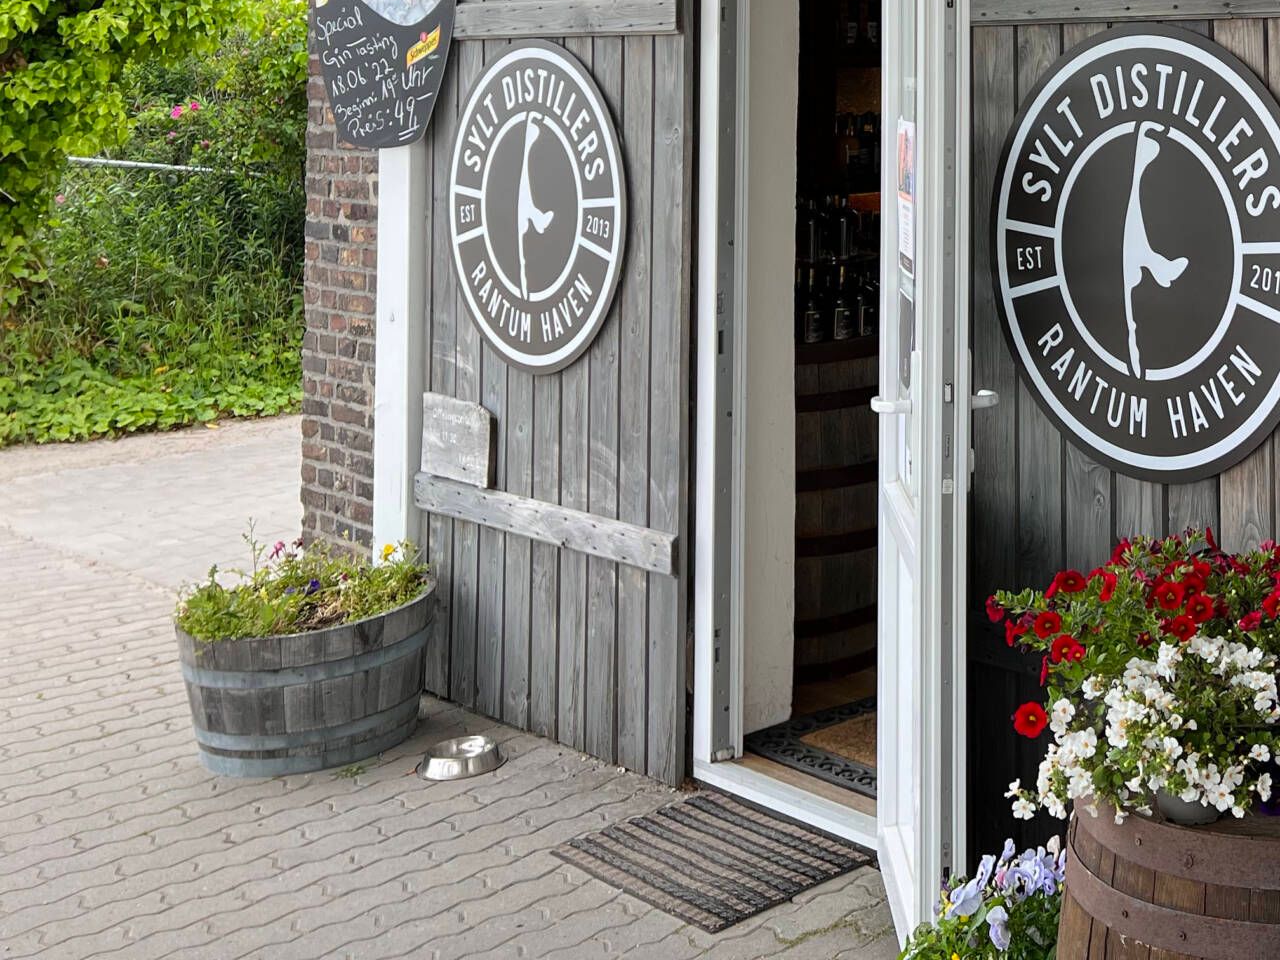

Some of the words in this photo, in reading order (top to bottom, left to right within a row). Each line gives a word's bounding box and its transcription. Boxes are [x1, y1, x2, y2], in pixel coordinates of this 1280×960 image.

[322, 47, 352, 68] Gin
[464, 94, 499, 172] SYLT
[501, 68, 604, 181] DISTILLERS
[1021, 96, 1083, 203] SYLT
[460, 204, 476, 222] EST
[586, 214, 610, 239] 2013
[1016, 246, 1043, 271] EST
[471, 260, 532, 343] RANTUM
[540, 272, 593, 342] HAVEN
[1037, 322, 1148, 438] RANTUM
[1166, 344, 1263, 439] HAVEN
